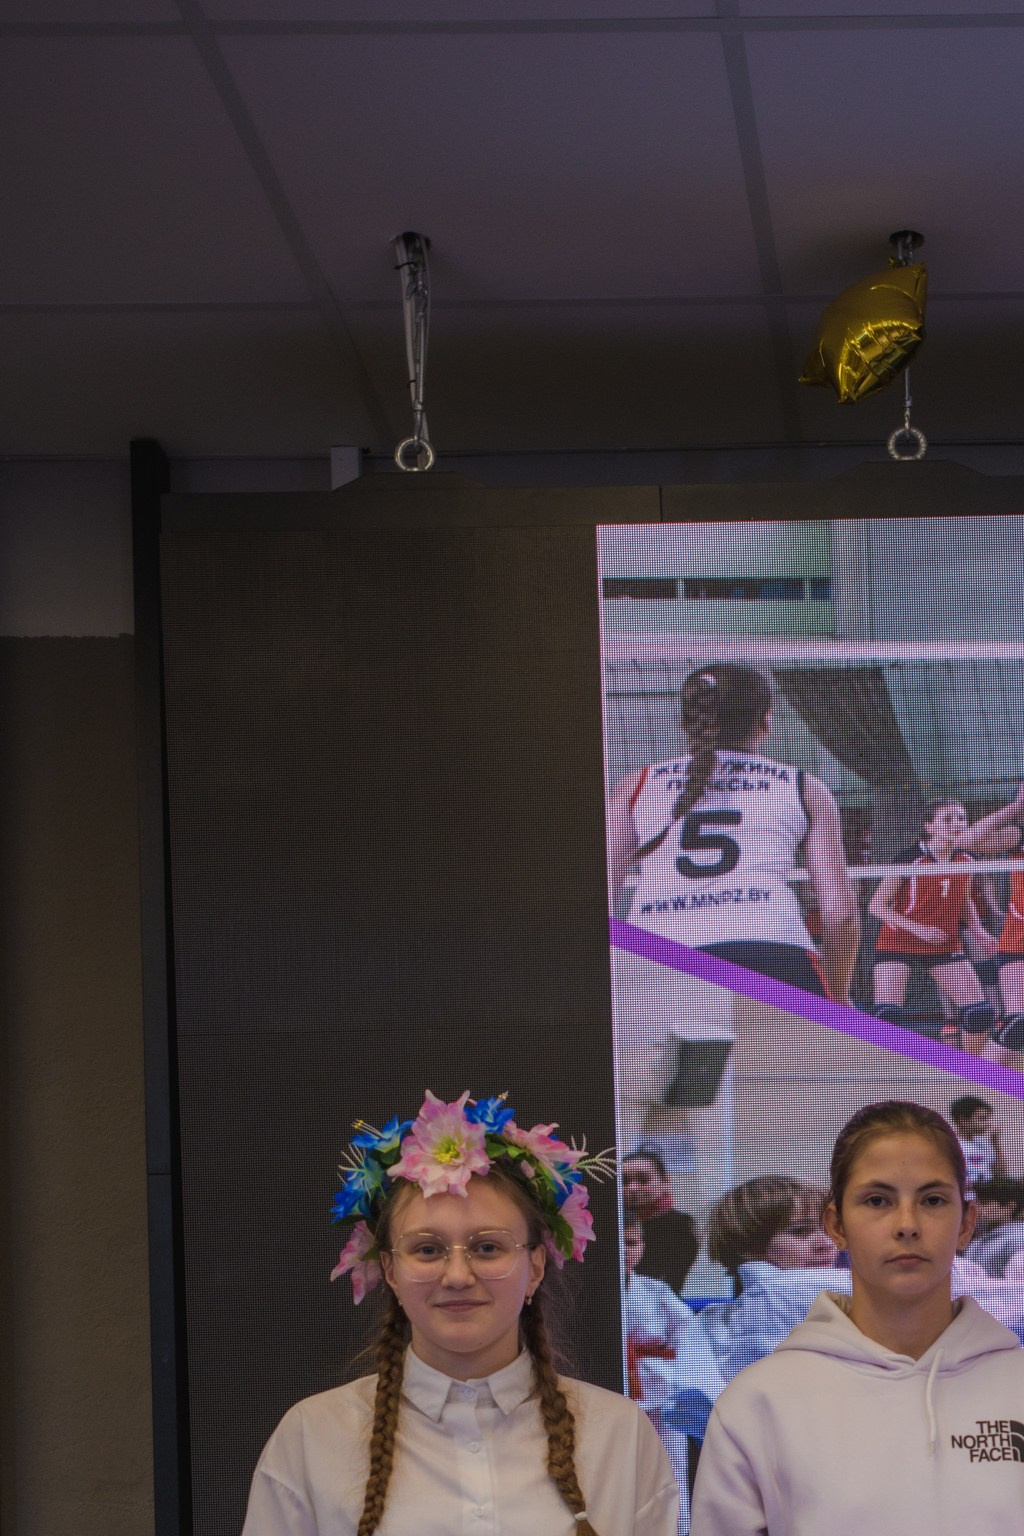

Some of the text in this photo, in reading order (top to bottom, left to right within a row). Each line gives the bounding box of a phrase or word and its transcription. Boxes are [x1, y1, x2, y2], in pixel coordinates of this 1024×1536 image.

[674, 810, 742, 879] 5
[976, 1420, 1009, 1434] THE
[951, 1434, 1011, 1449] NORTH
[970, 1448, 1012, 1463] FACE
